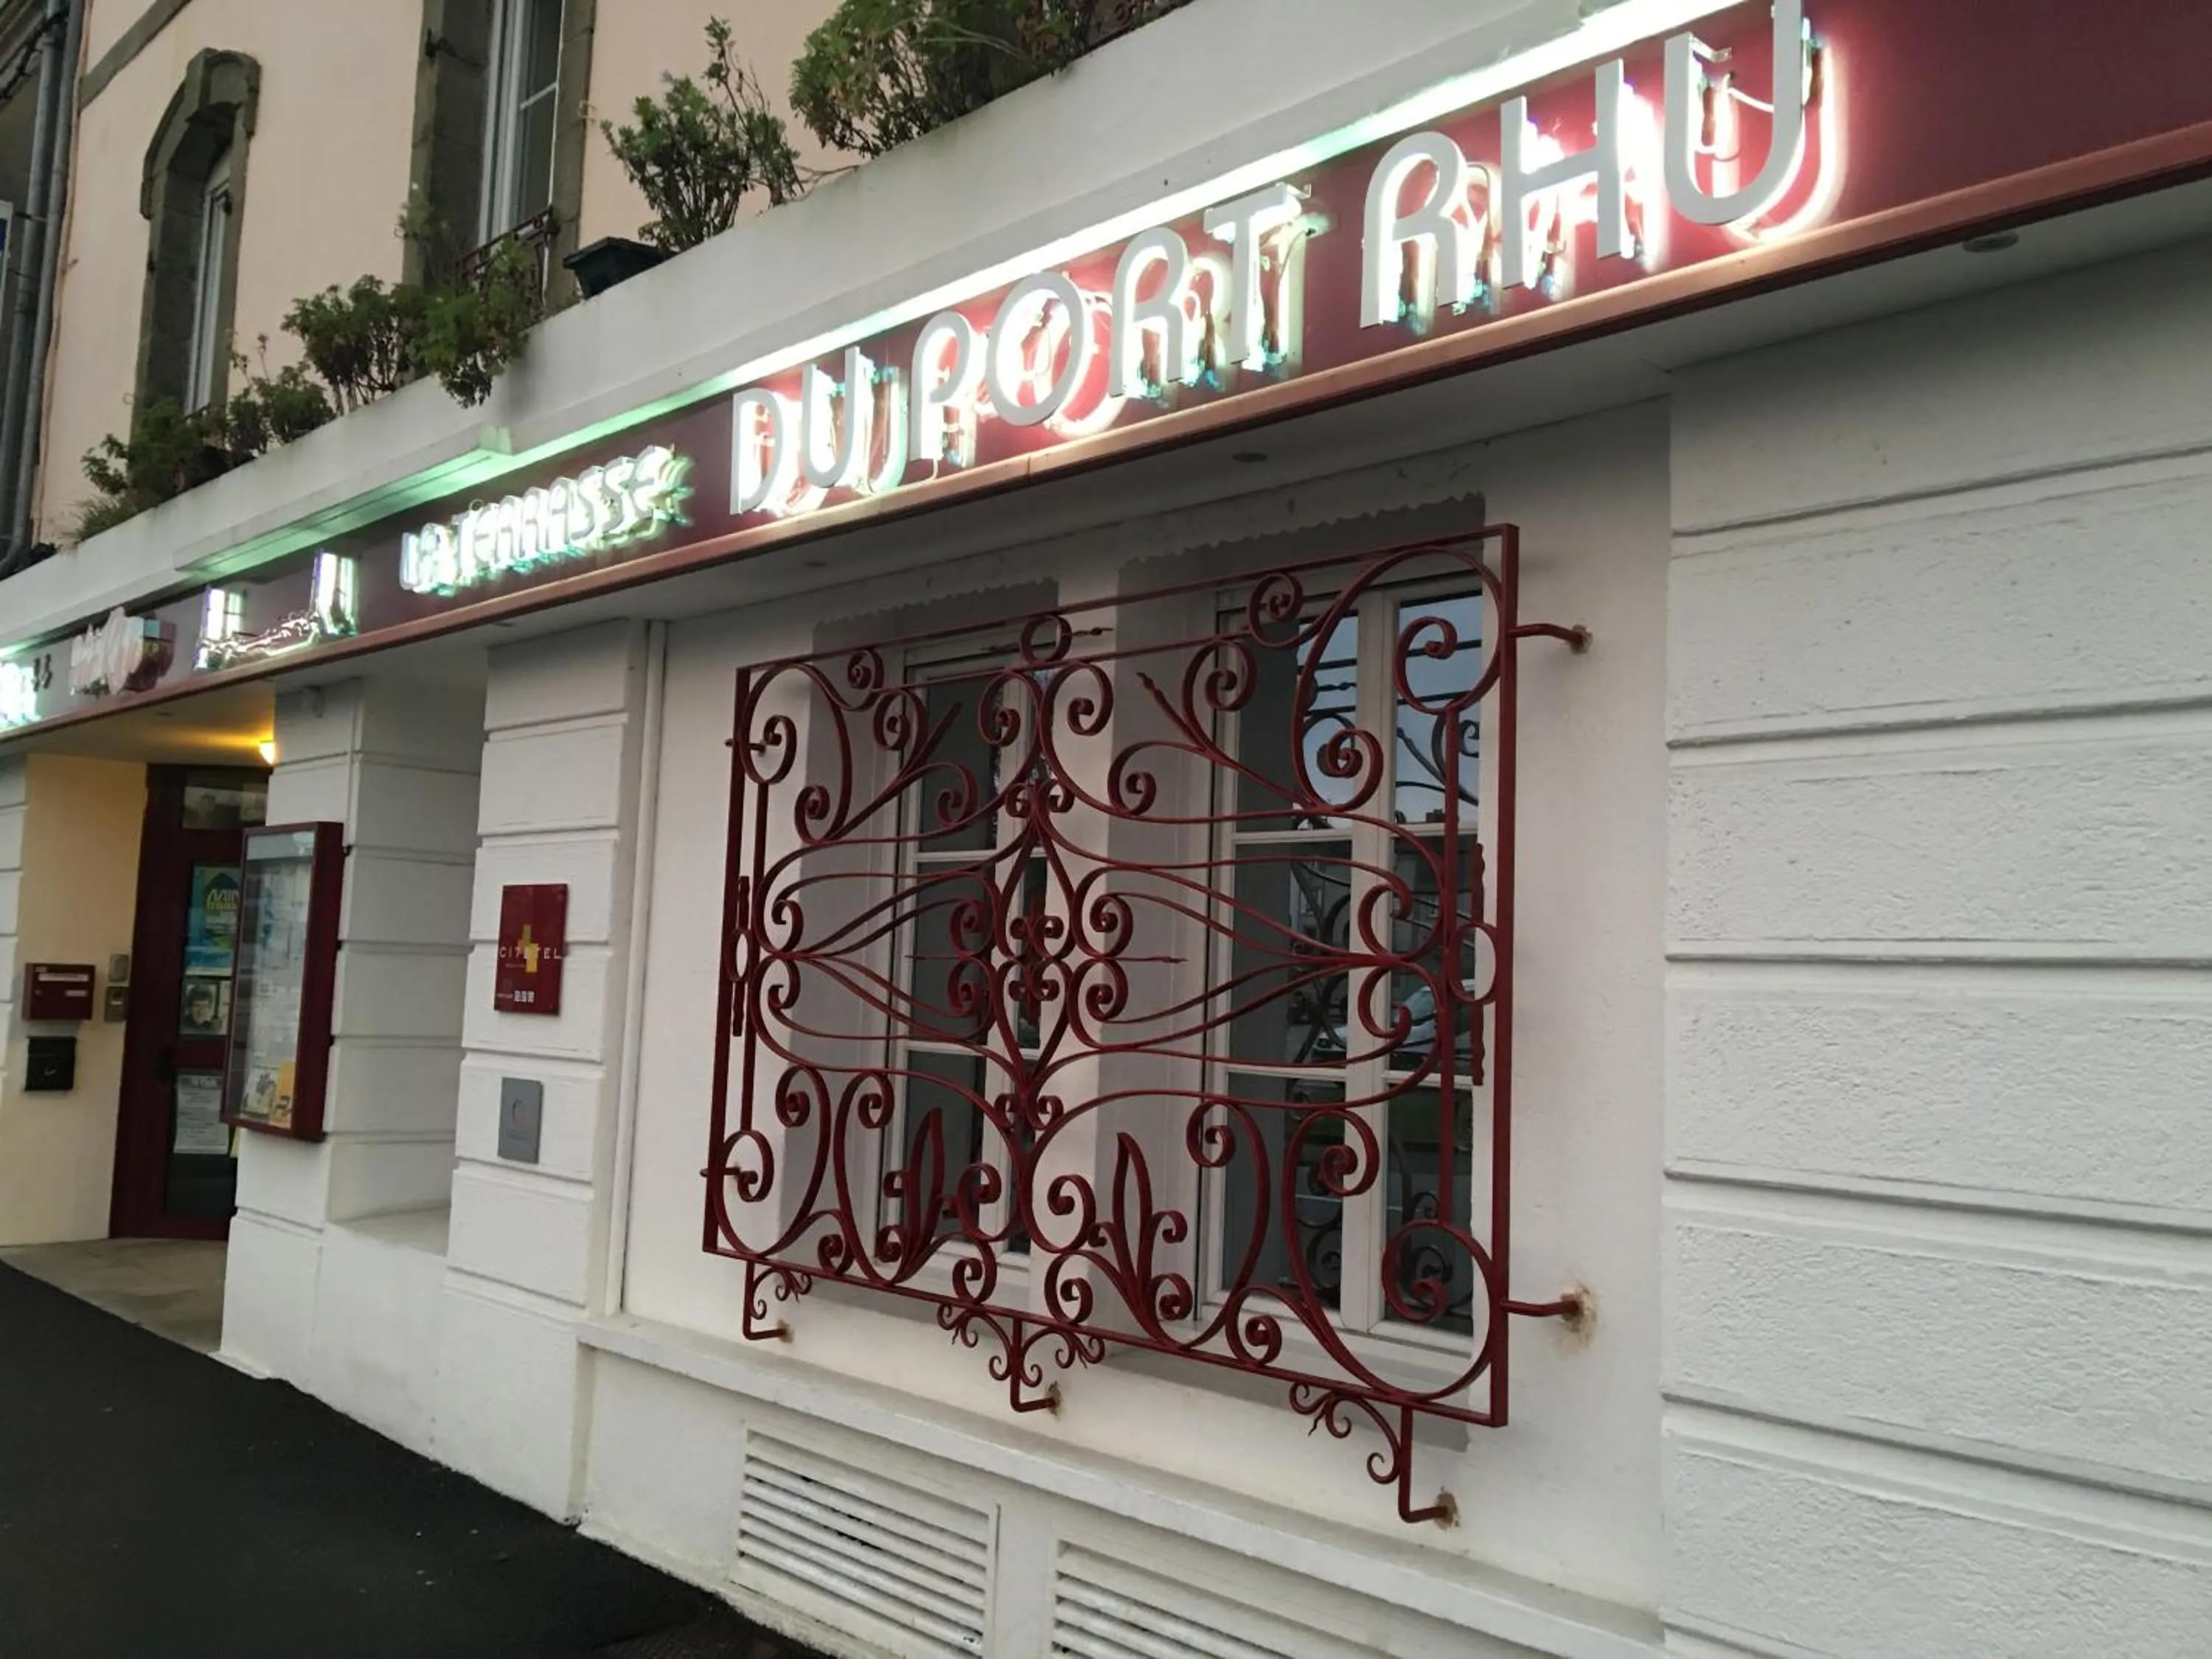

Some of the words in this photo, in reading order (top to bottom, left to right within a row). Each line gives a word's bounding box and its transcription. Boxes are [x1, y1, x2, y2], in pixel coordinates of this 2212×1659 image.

[729, 345, 861, 516] DU
[909, 182, 1302, 462] PORT
[1360, 0, 1804, 330] RHU
